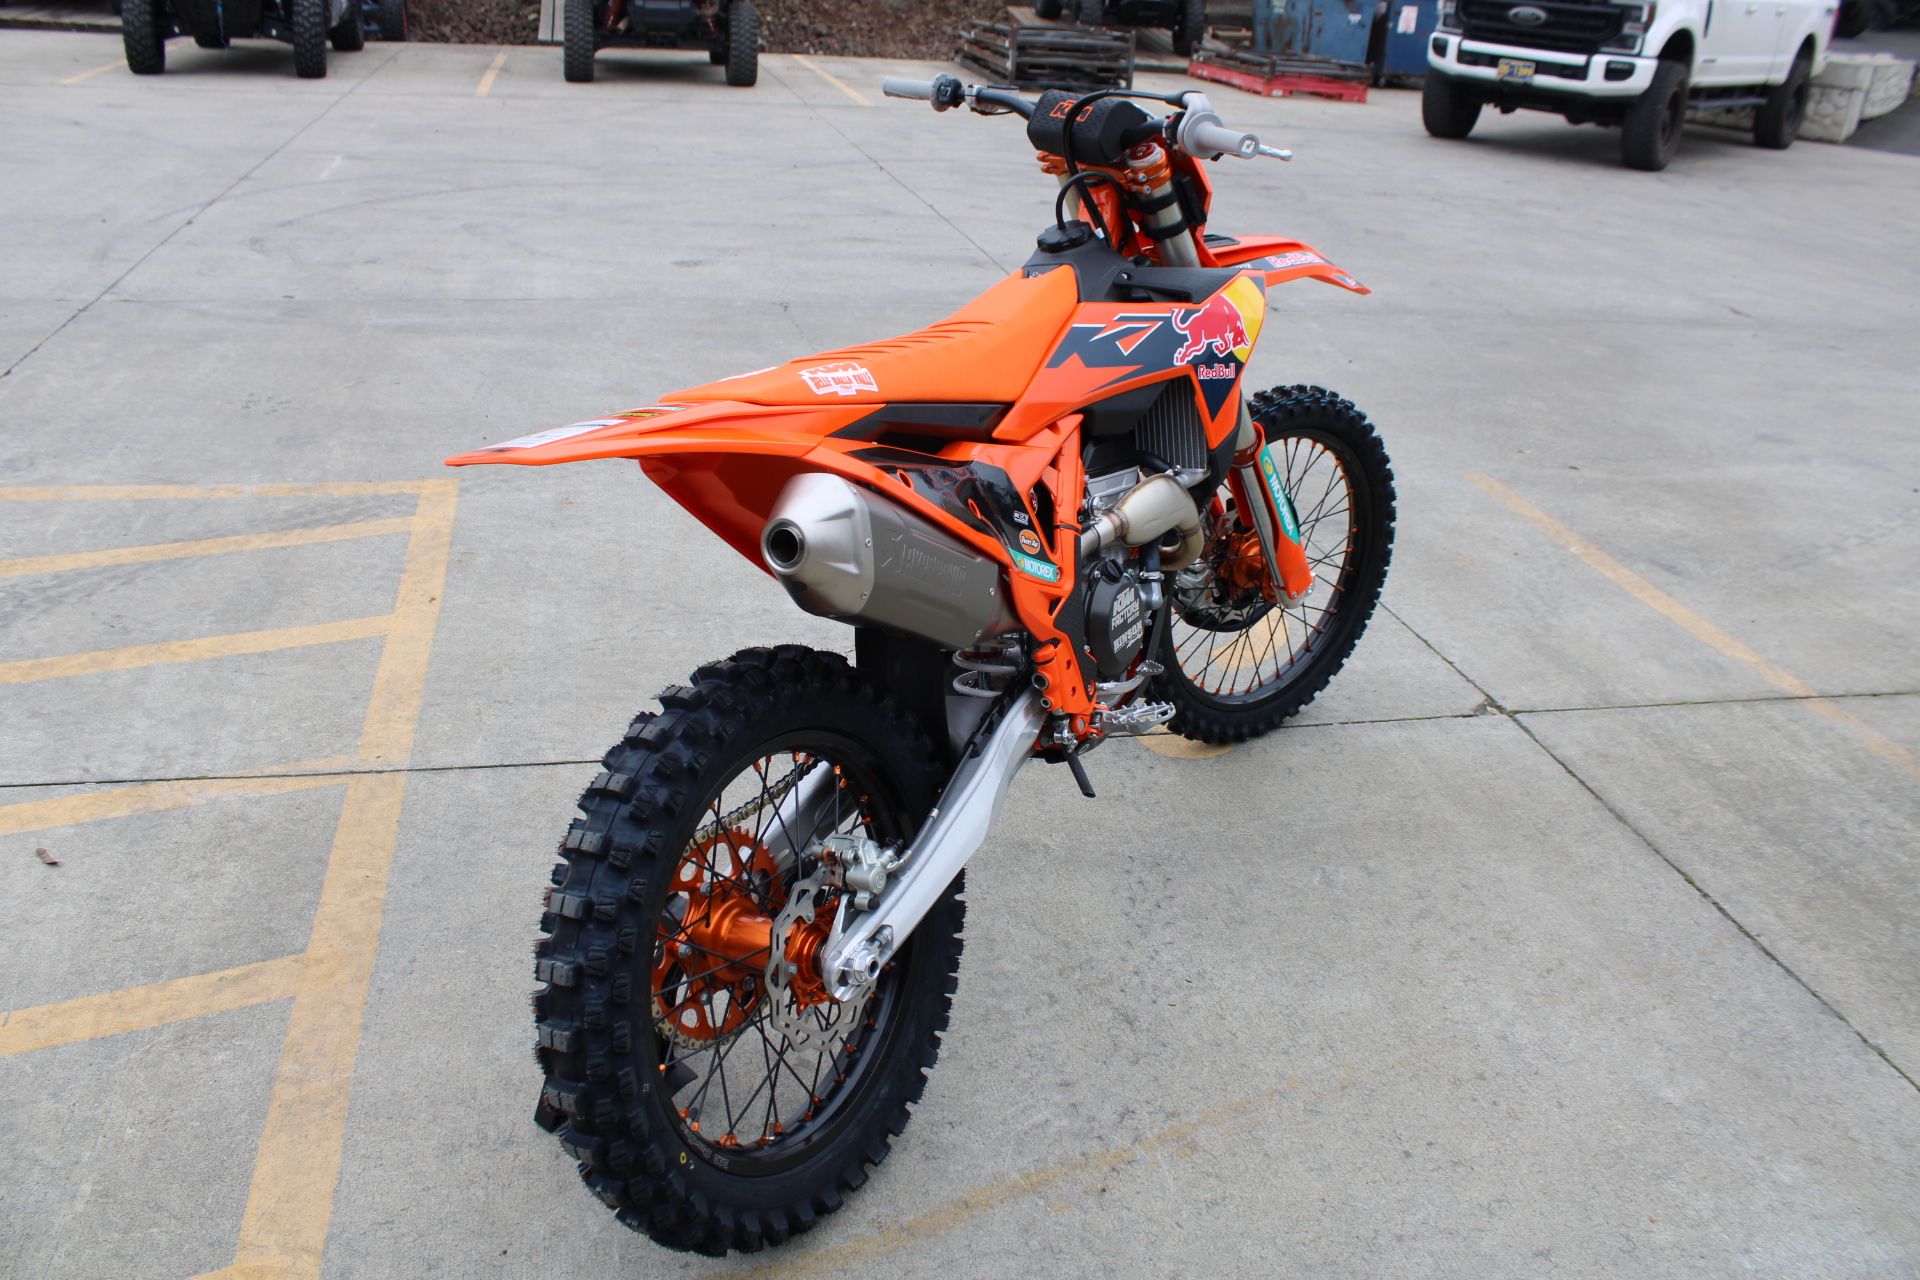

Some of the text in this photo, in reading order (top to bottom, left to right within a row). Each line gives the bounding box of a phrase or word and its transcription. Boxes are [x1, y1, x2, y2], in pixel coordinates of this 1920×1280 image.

[1198, 363, 1236, 379] Red Bull
[1270, 474, 1293, 535] MOTOREX
[1021, 535, 1039, 548] Twin Air
[1024, 558, 1054, 579] MOTOREX
[1112, 587, 1135, 616] KTM
[1111, 598, 1140, 631] FACTORY
